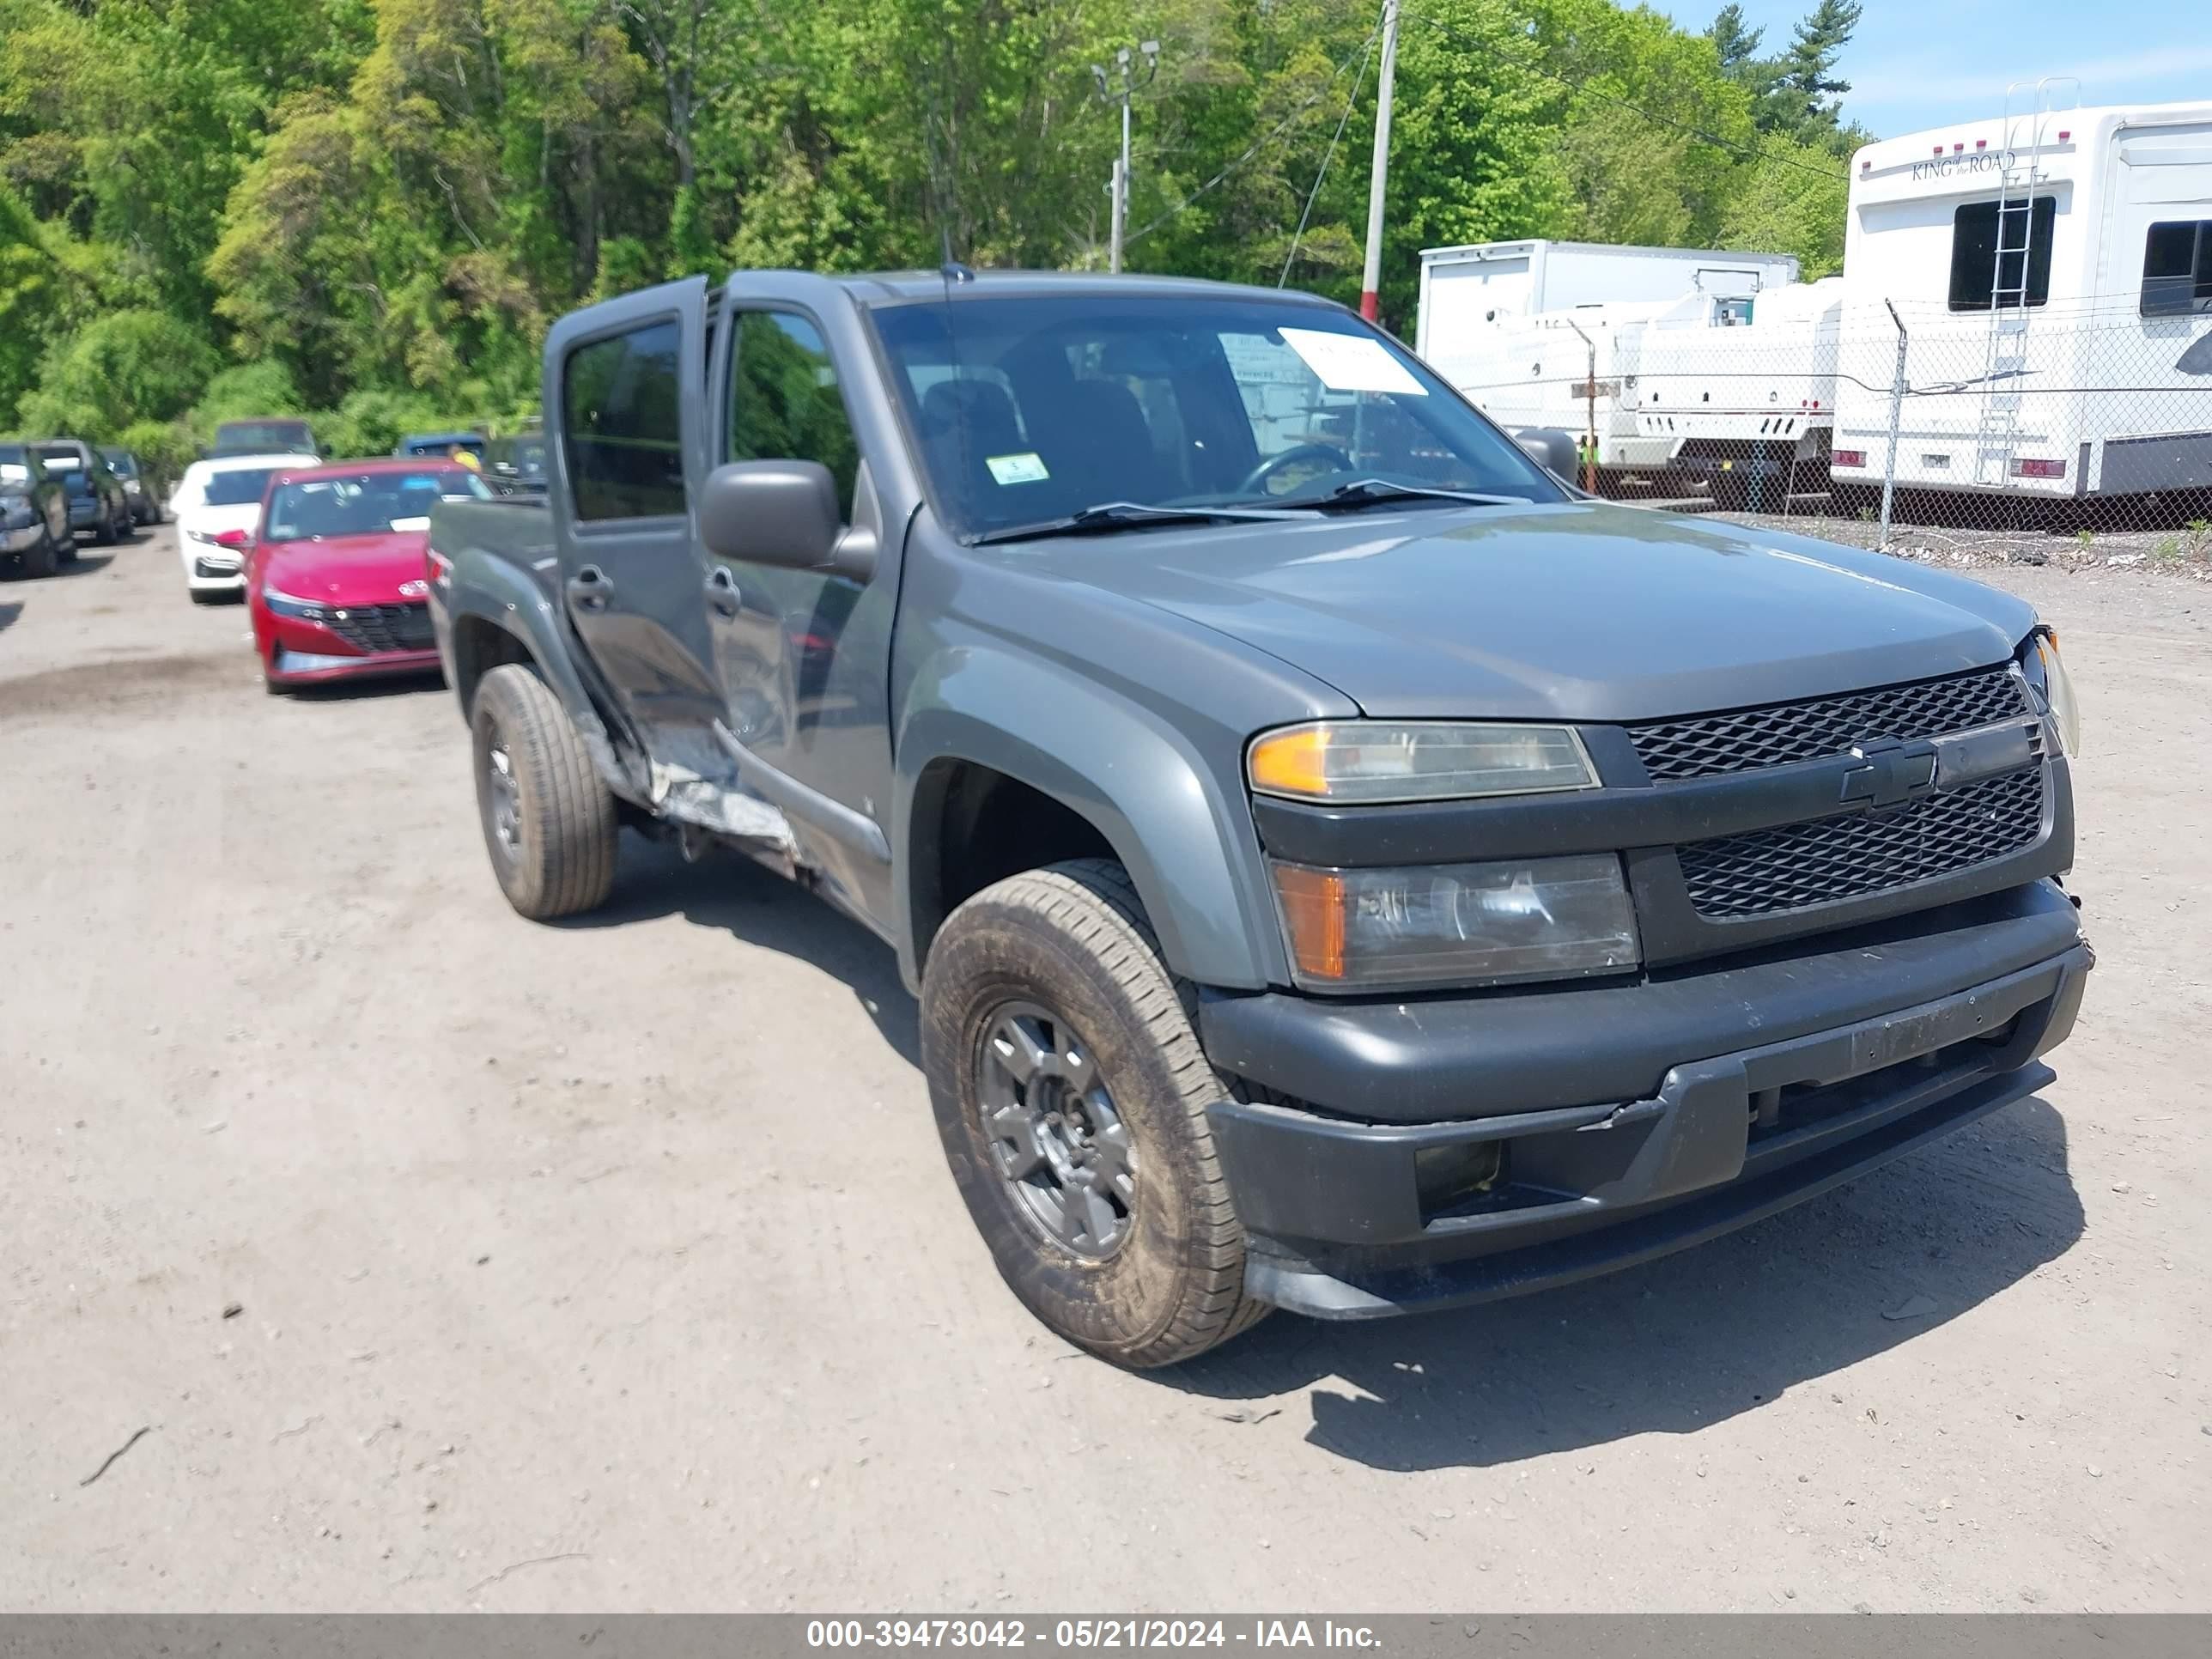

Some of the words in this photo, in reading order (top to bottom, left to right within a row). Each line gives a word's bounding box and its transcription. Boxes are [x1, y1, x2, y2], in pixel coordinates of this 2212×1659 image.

[1912, 161, 1952, 180] KING
[1953, 156, 1961, 165] of
[1970, 152, 2015, 173] ROAD
